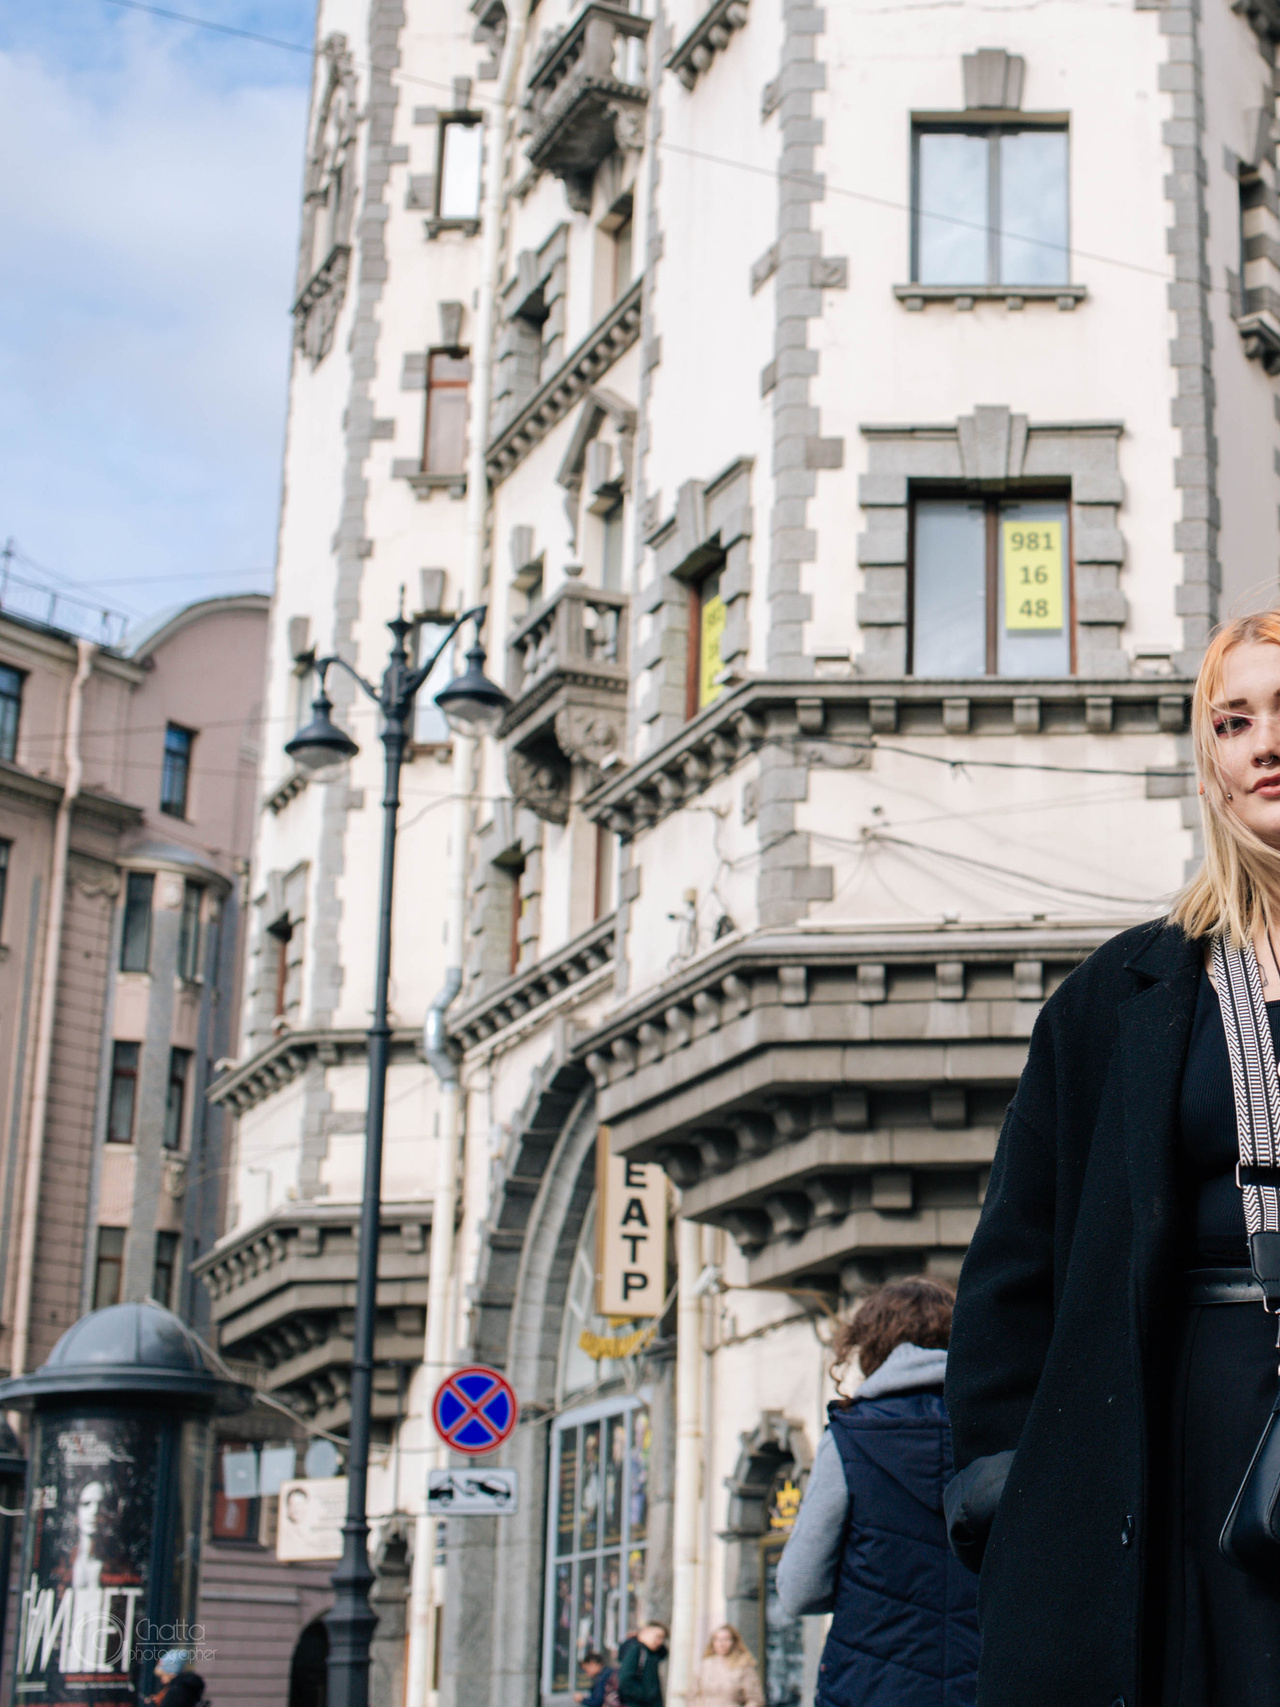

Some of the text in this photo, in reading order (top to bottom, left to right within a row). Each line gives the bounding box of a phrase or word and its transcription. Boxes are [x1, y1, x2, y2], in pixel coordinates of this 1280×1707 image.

[1011, 532, 1054, 551] 981
[1020, 564, 1048, 584] 16
[1019, 598, 1048, 618] 48
